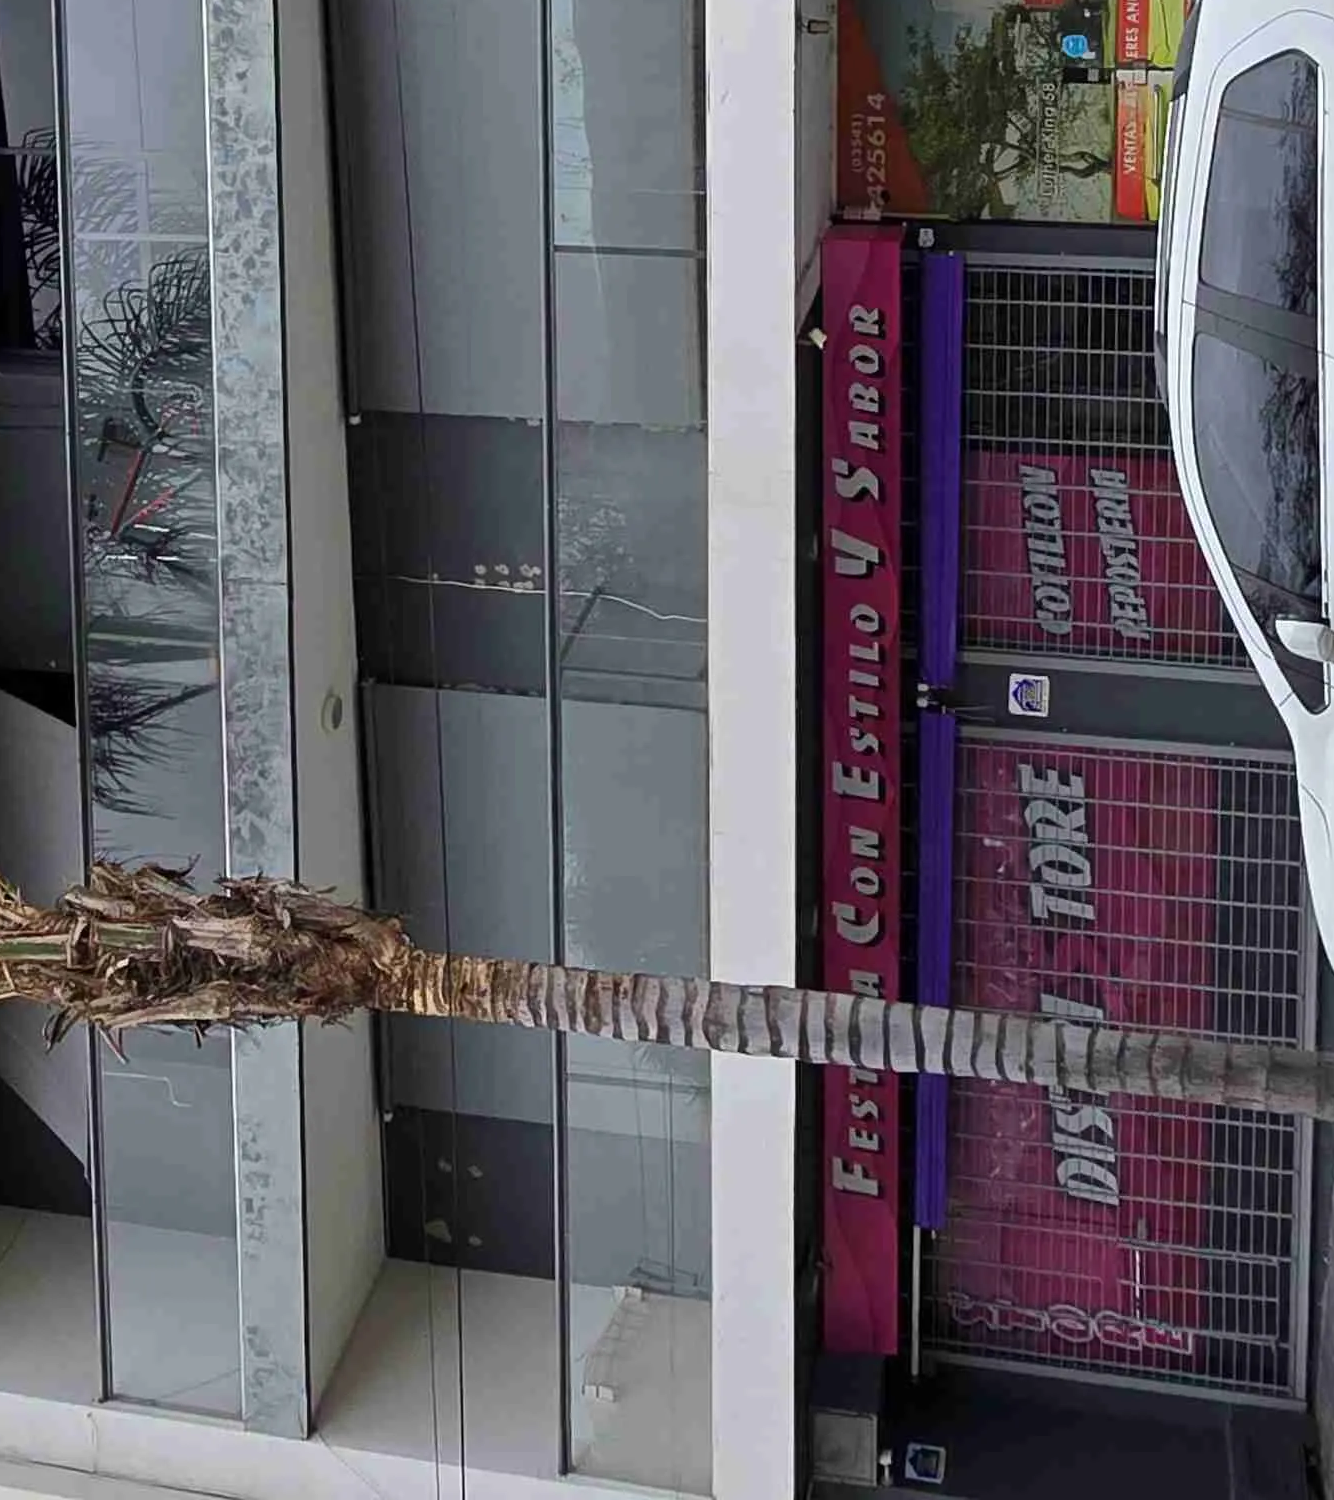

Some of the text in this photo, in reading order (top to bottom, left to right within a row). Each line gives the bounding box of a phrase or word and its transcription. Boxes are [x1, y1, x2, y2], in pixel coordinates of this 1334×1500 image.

[850, 113, 866, 173] (03541)
[1041, 82, 1056, 102] 58
[831, 303, 880, 502] SABOR
[830, 528, 880, 576] Y
[1018, 464, 1072, 634] COTILLON
[1091, 468, 1150, 640] REPOSTERIA
[831, 603, 880, 800] ESTILO
[832, 826, 880, 944] CON
